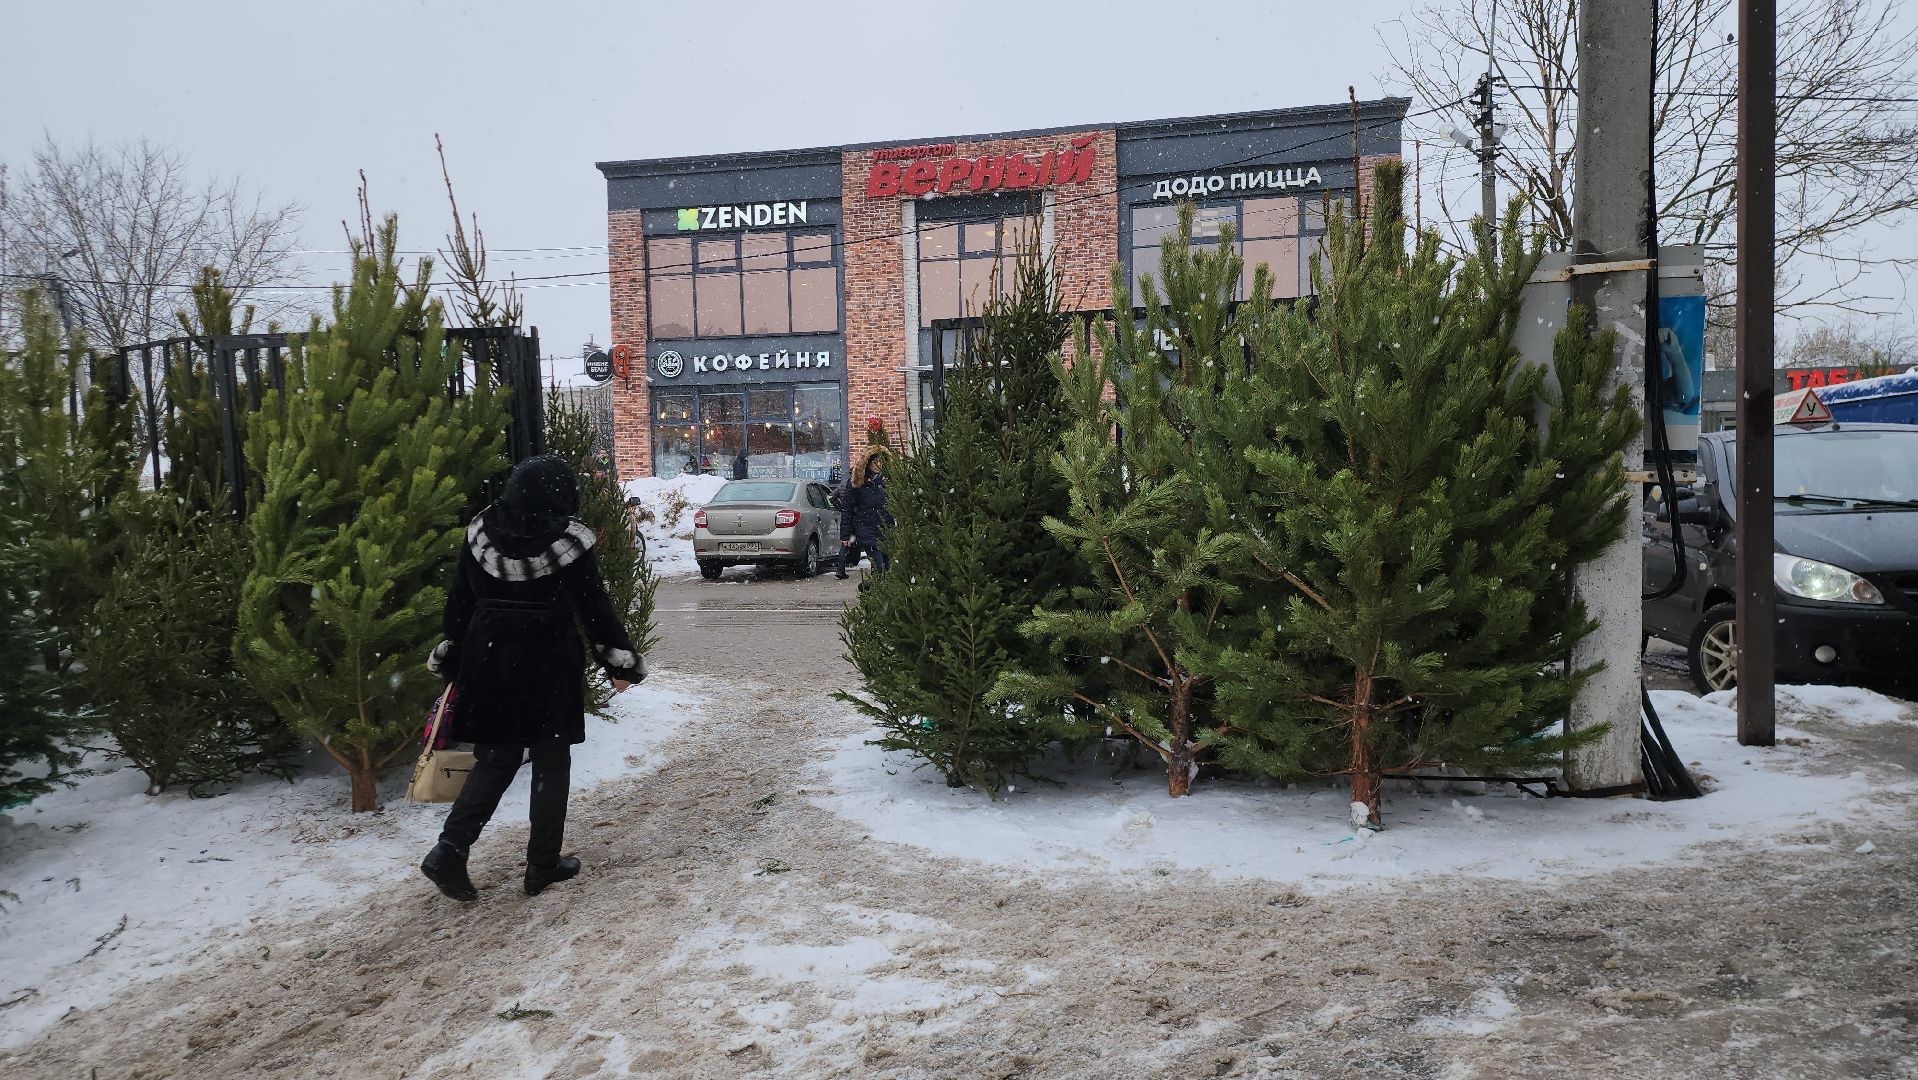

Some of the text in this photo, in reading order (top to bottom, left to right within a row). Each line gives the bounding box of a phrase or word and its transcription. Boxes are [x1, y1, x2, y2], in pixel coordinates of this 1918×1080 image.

[1153, 166, 1322, 200] ДОДО ПИЦЦА
[701, 200, 807, 229] ZENDEN
[693, 350, 830, 373] КОФЕЙНЯ
